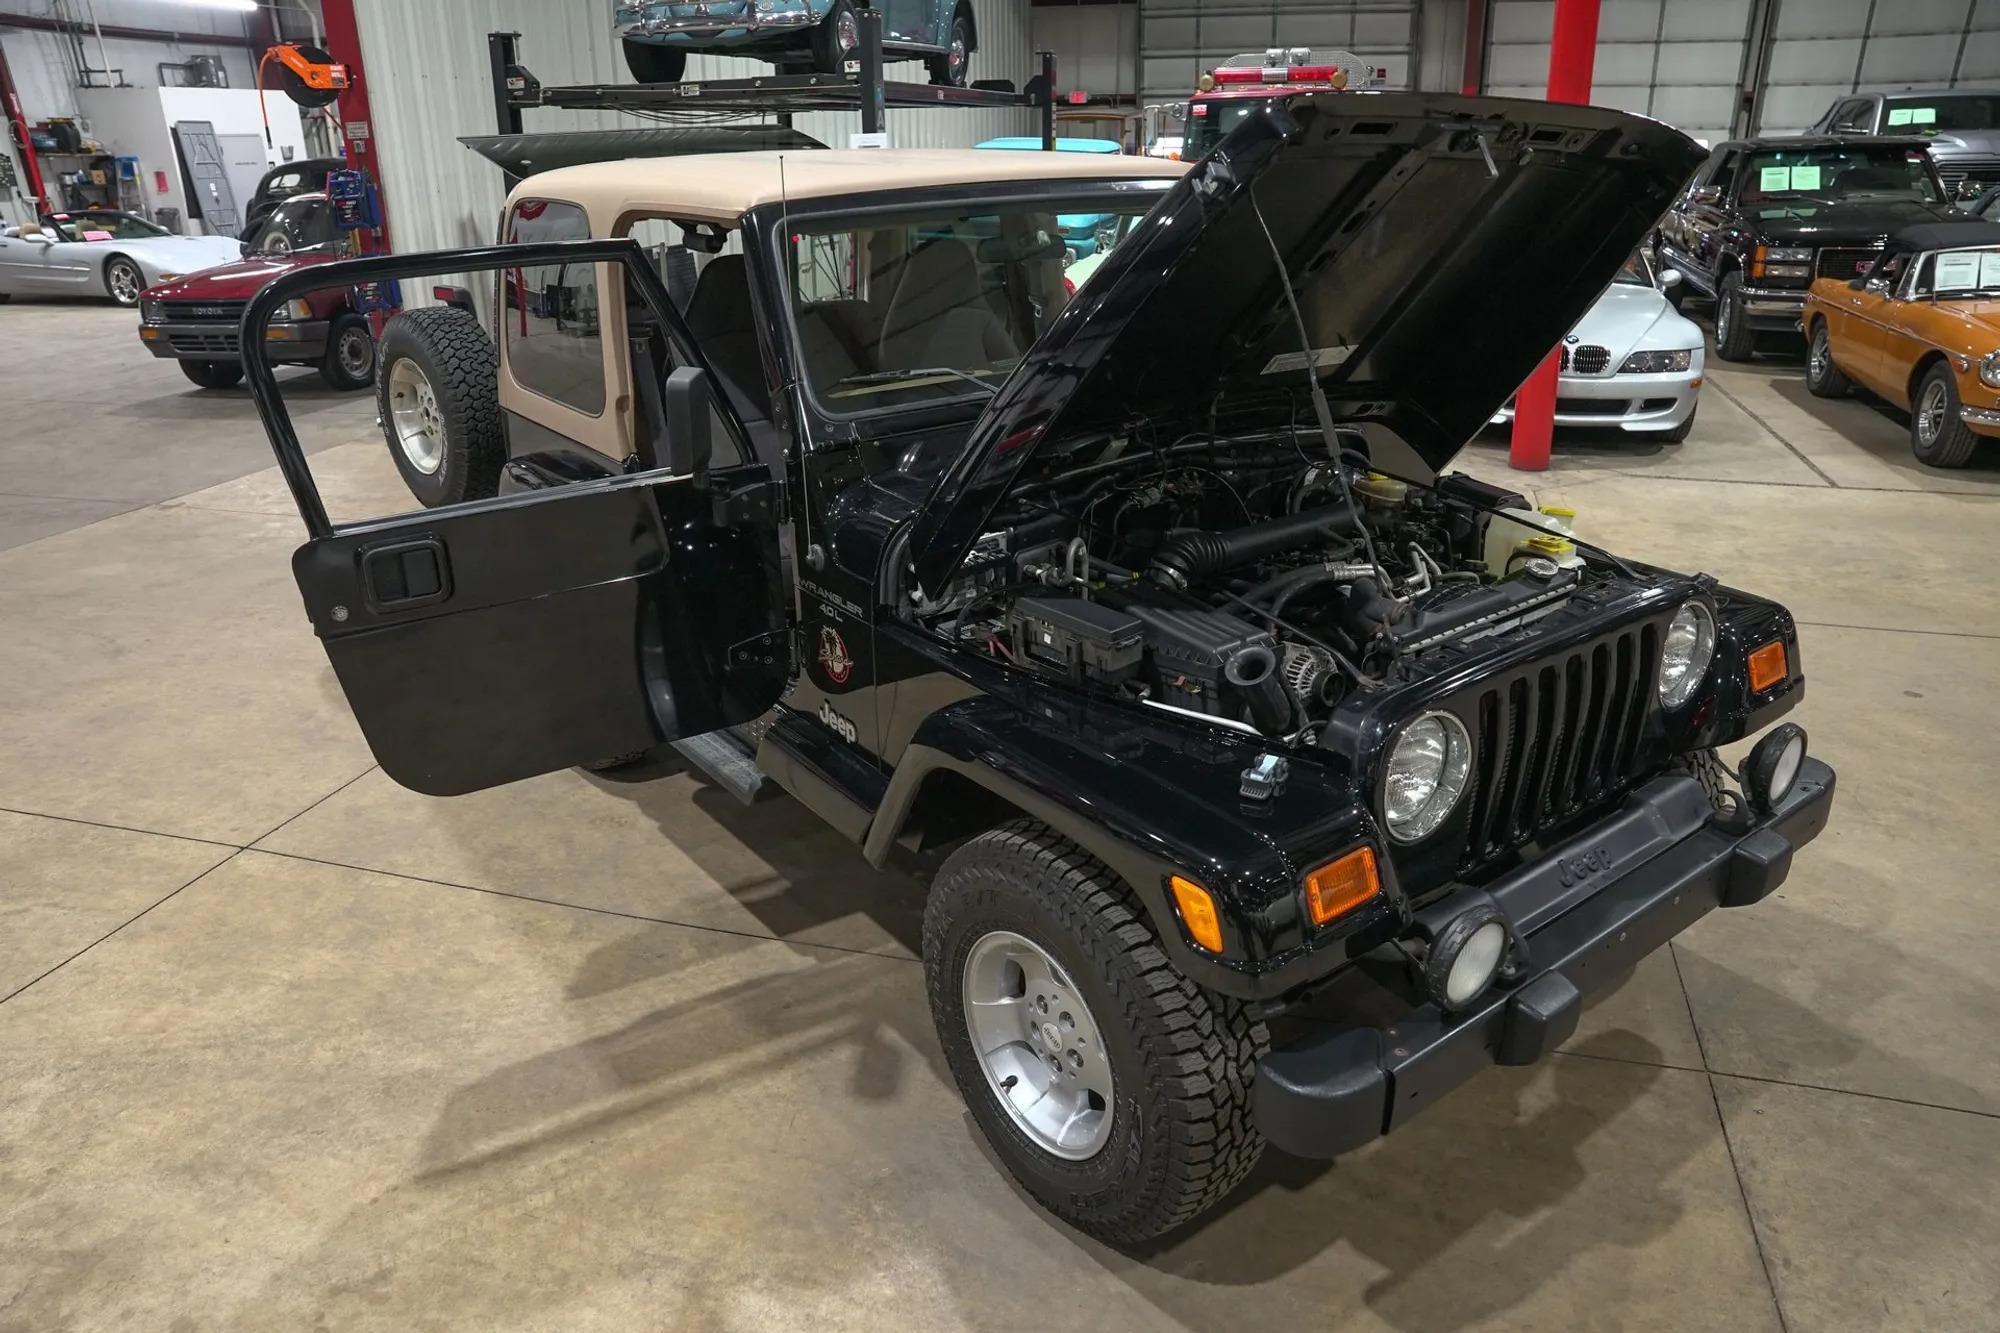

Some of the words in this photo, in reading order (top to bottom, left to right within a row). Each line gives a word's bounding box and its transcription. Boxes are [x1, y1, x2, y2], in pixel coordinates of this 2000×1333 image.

[191, 307, 223, 316] TOYOTA
[800, 579, 863, 618] WRANGLER
[819, 699, 857, 744] Jeep
[1558, 846, 1612, 889] Jeep
